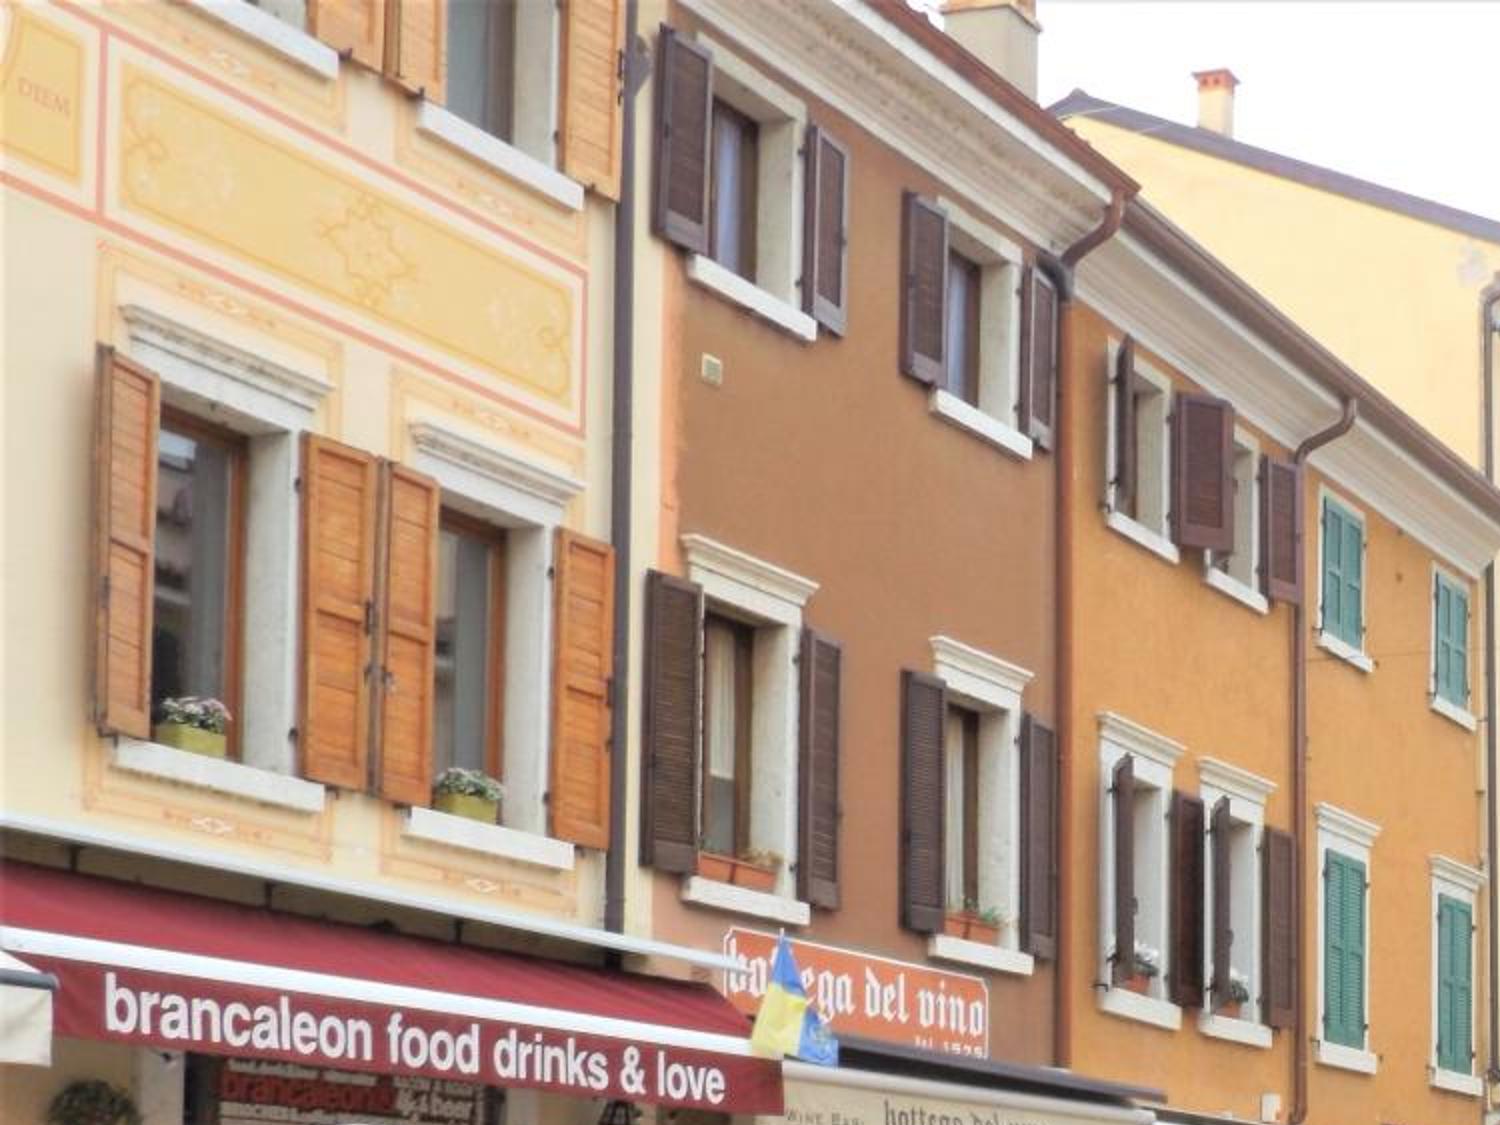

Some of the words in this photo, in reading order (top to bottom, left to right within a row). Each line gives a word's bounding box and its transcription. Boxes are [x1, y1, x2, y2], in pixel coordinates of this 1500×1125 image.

[105, 971, 373, 1061] brancaleon
[387, 1012, 481, 1075] food
[493, 1028, 609, 1091] drinks
[620, 1045, 647, 1096] &
[656, 1050, 726, 1105] love
[728, 936, 855, 1024] boega
[864, 965, 910, 1024] del
[916, 980, 985, 1036] vino
